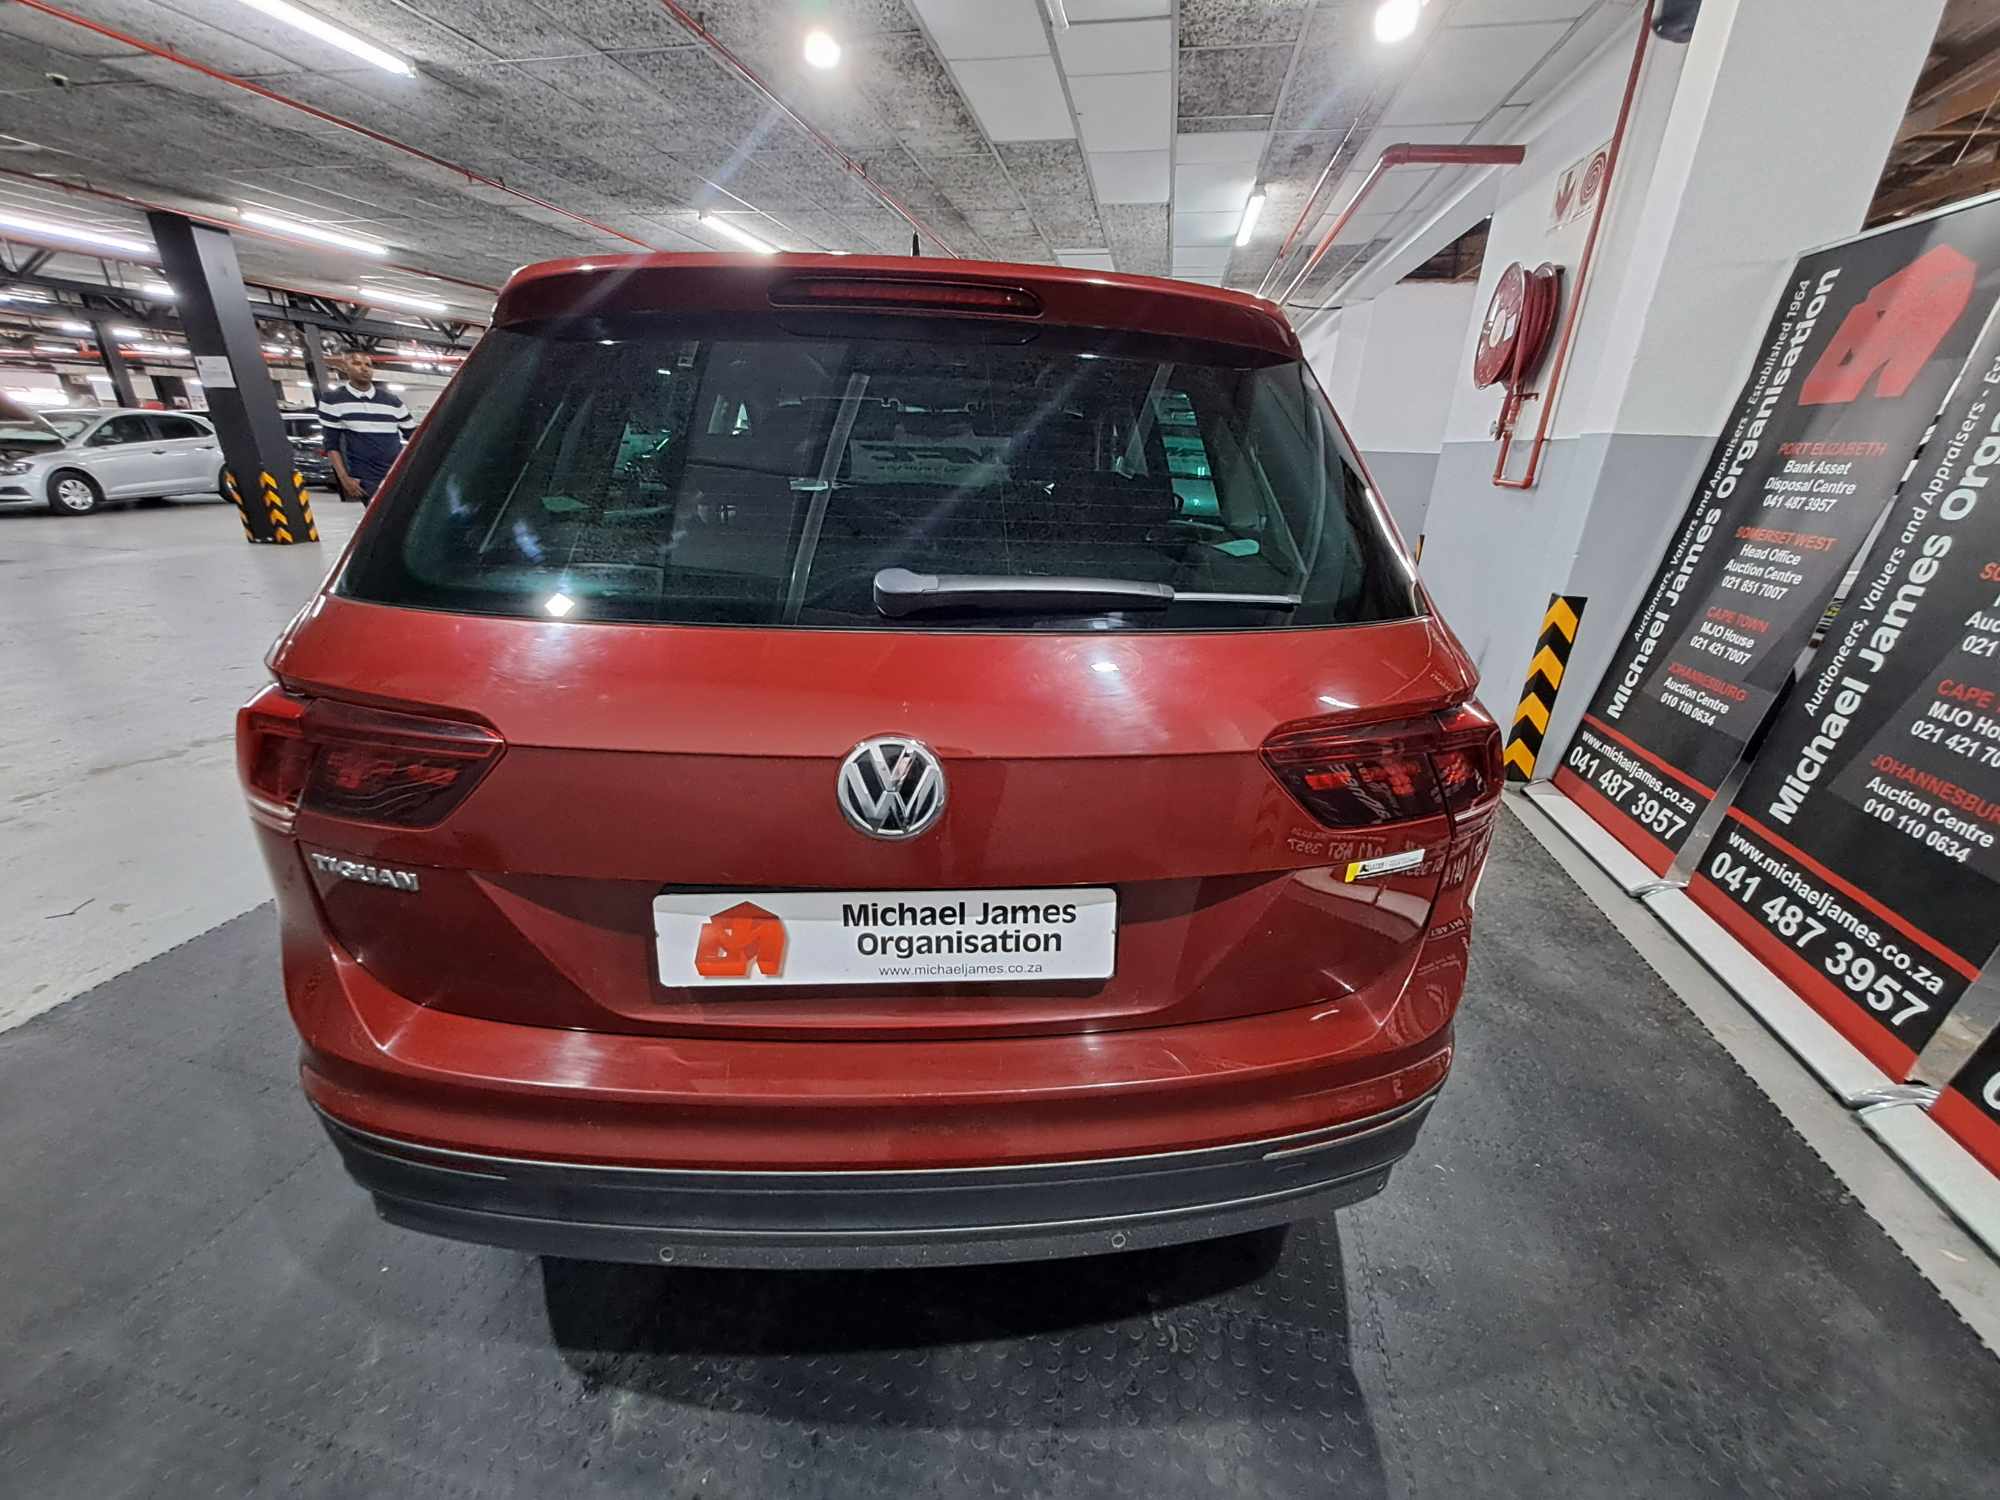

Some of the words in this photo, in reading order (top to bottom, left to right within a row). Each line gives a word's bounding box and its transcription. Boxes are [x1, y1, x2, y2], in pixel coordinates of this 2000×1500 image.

[1670, 519, 1698, 566] Valuers
[1696, 490, 1712, 517] and
[1709, 417, 1748, 488] Appraisers
[1748, 322, 1792, 405] Established
[1787, 279, 1810, 317] 1964
[1784, 460, 1813, 474] Bank
[1813, 461, 1852, 475] Asset
[1606, 610, 1670, 719] Michael
[1665, 508, 1722, 607] James
[1716, 267, 1841, 499] Organisation
[1764, 477, 1813, 494] Disposal
[1812, 478, 1857, 495] Centre
[1762, 494, 1783, 508] 041
[1784, 497, 1805, 510] 487
[1804, 499, 1838, 513] 3957
[1860, 546, 1905, 613] Valuers
[1901, 506, 1928, 544] and
[1920, 401, 1986, 506] Appraisers
[1740, 543, 1769, 559] Head
[1768, 549, 1802, 566] Office
[1794, 534, 1839, 552] WEST
[1723, 558, 1764, 578] Auction
[1764, 569, 1803, 585] Centre
[1721, 575, 1740, 589] 021
[1740, 579, 1762, 595] 851
[1760, 585, 1789, 601] 7007
[1690, 635, 1709, 651] 021
[1708, 641, 1727, 656] 421
[1723, 647, 1752, 665] 7007
[1700, 621, 1725, 638] MJO
[1722, 629, 1755, 649] House
[1962, 635, 2000, 657] 021
[1769, 676, 1870, 825] Michael
[1858, 534, 1953, 673] James
[1936, 679, 1994, 708] CAPE
[1660, 692, 1679, 708] 010
[1678, 700, 1693, 715] 110
[1691, 707, 1717, 726] 0634
[1663, 676, 1697, 699] Auction
[1696, 691, 1729, 714] Centre
[1927, 701, 1973, 728] MJO
[1910, 719, 1945, 744] 021
[1944, 734, 1981, 758] 421
[1582, 730, 1697, 815] www.michaeljames.co.za
[1569, 746, 1600, 779] 041
[1598, 769, 1635, 802] 487
[1631, 791, 1687, 840] 3957
[1865, 776, 1931, 817] Auction
[1932, 807, 1995, 848] Centre
[1863, 798, 1895, 823] 010
[1896, 814, 1926, 839] 110
[1925, 830, 1971, 863] 0634
[312, 853, 419, 891] TIGUAN
[842, 901, 966, 928] Michael
[975, 901, 1077, 926] James
[1728, 831, 1945, 996] www.michaeljames.co.za
[857, 929, 1062, 959] Organisation
[1710, 851, 1762, 903] 041
[1761, 895, 1828, 948] 487
[1824, 941, 1930, 1026] 3957
[879, 963, 1043, 977] www.michaeljames.co.za
